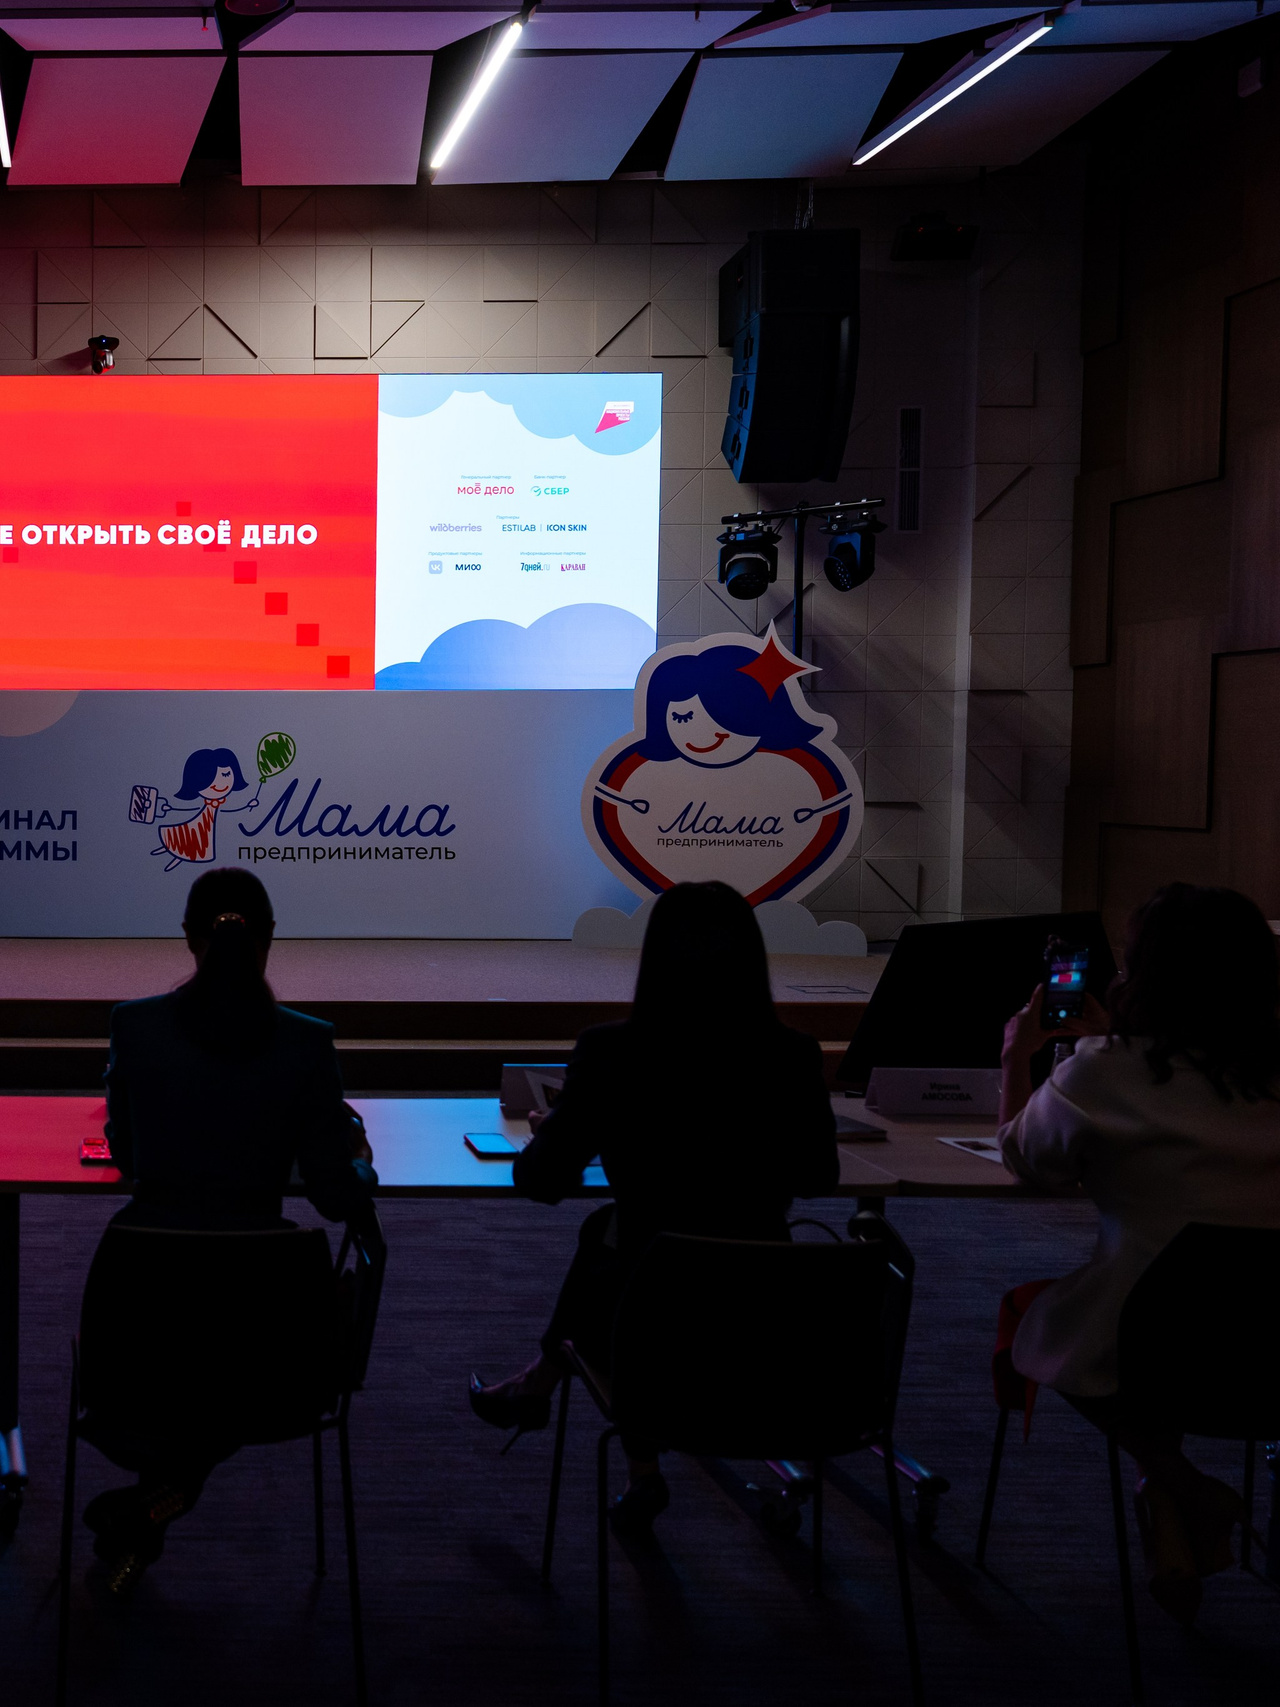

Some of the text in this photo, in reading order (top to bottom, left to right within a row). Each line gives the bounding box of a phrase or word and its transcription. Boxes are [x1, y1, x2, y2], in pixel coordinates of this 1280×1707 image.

[484, 486, 515, 496] дело
[429, 523, 482, 532] wildberries
[502, 524, 536, 532] ESTILAB
[568, 524, 587, 532] SKIN
[21, 524, 150, 545] ОТКРЫТЬ
[157, 520, 231, 545] СВОЁ
[241, 524, 318, 548] ДЕЛО
[237, 777, 456, 838] Мама
[657, 801, 784, 835] Мама
[657, 838, 784, 848] предприниматель
[238, 845, 456, 864] предприниматель
[922, 1092, 972, 1101] АМОСОВА
